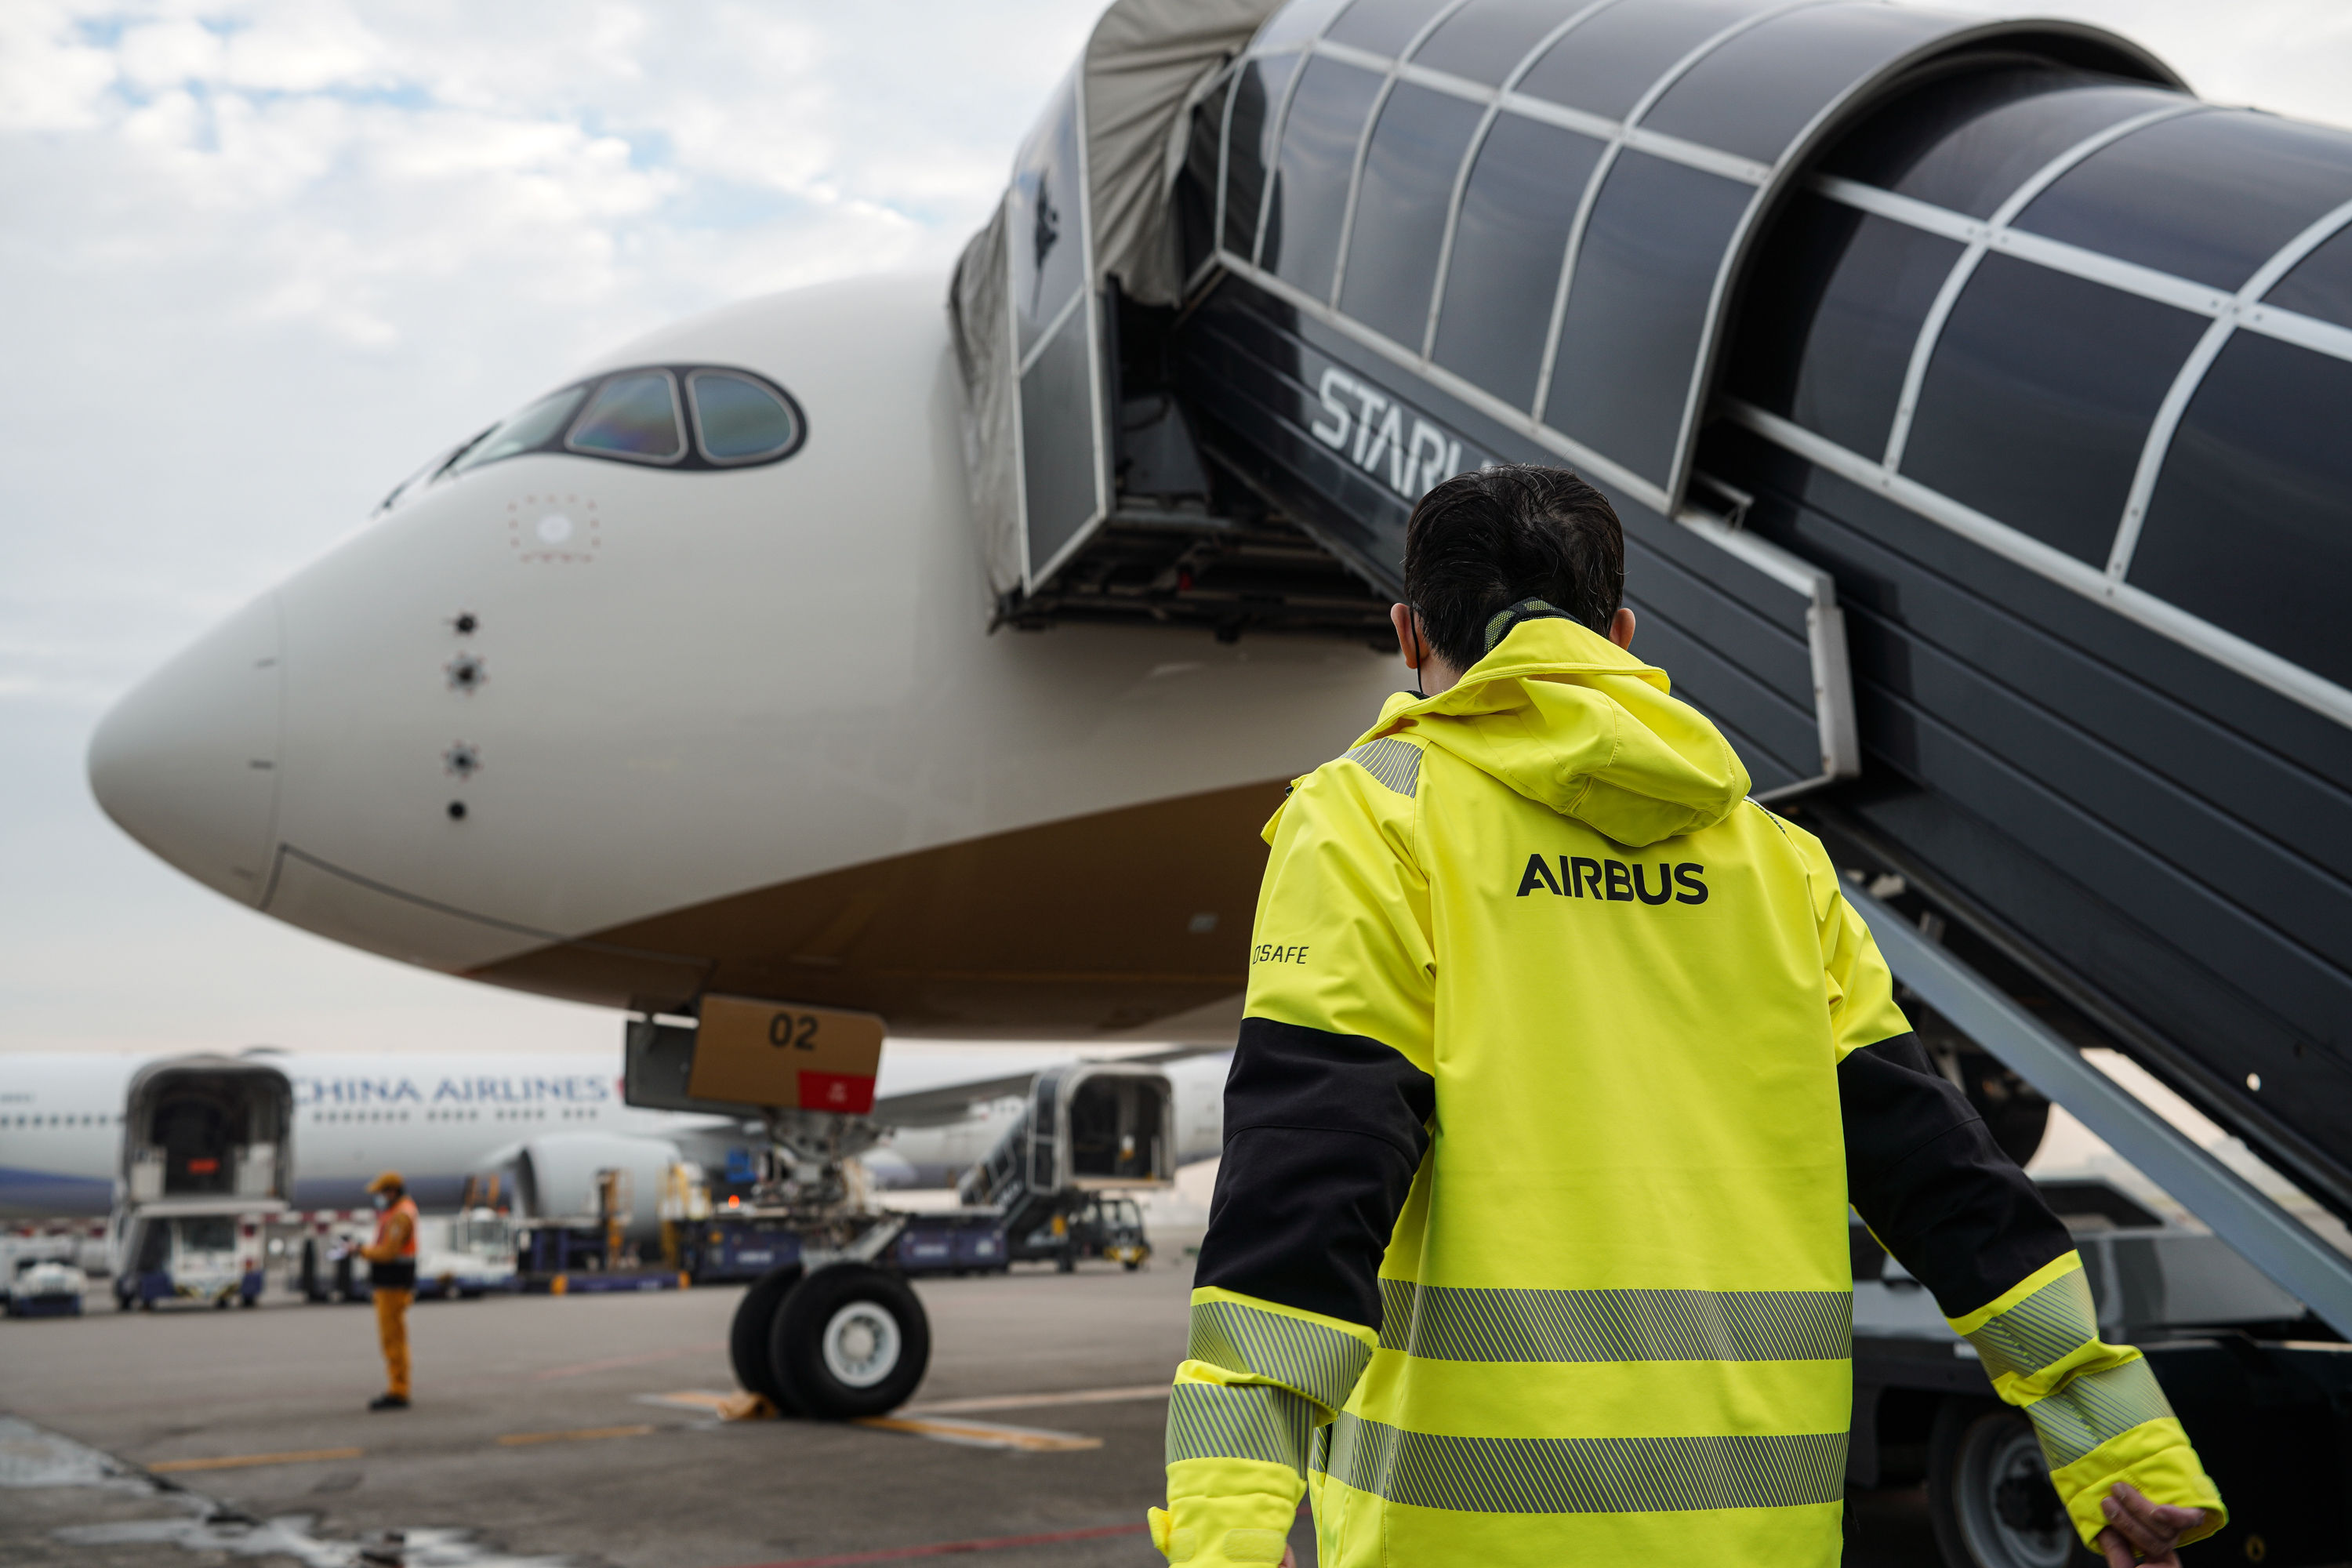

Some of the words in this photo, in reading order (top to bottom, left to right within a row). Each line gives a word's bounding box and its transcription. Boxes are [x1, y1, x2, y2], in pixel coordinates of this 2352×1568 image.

[1516, 853, 1708, 906] AIRBUS
[769, 1012, 818, 1051] 02
[434, 1076, 609, 1104] AIRLINES
